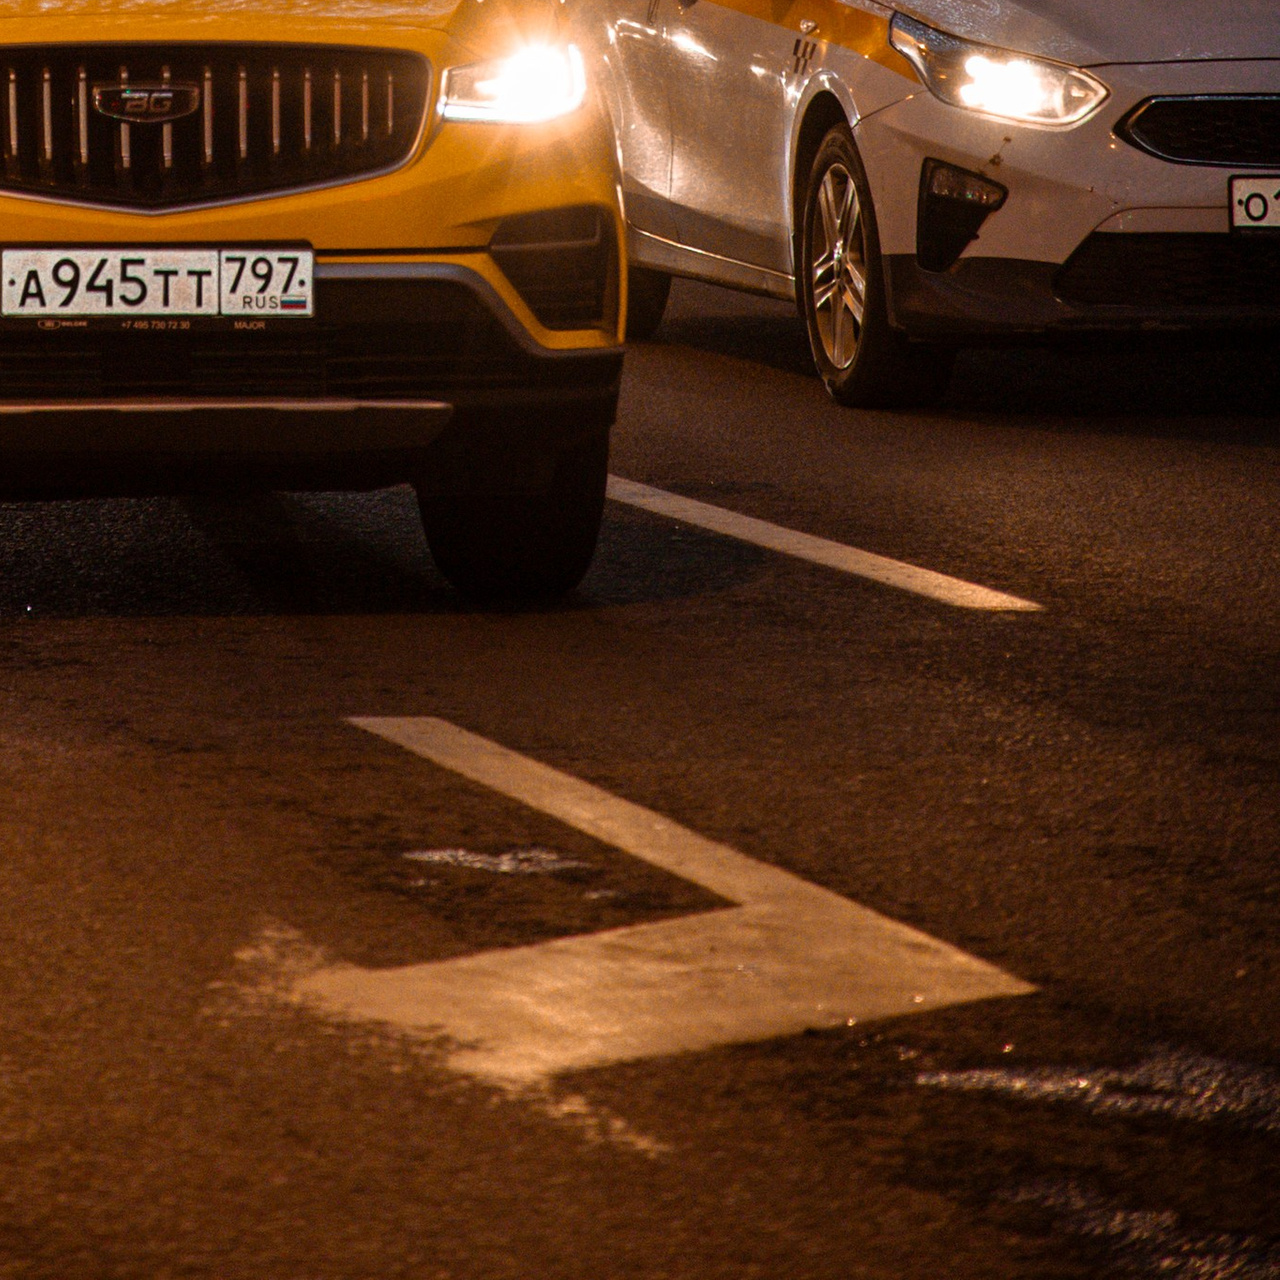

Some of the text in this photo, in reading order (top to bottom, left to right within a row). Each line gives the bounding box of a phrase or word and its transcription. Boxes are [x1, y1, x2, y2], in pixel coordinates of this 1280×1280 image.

[19, 256, 299, 308] А945ТТ 797
[242, 295, 279, 309] RUS
[234, 320, 265, 330] MAJOR
